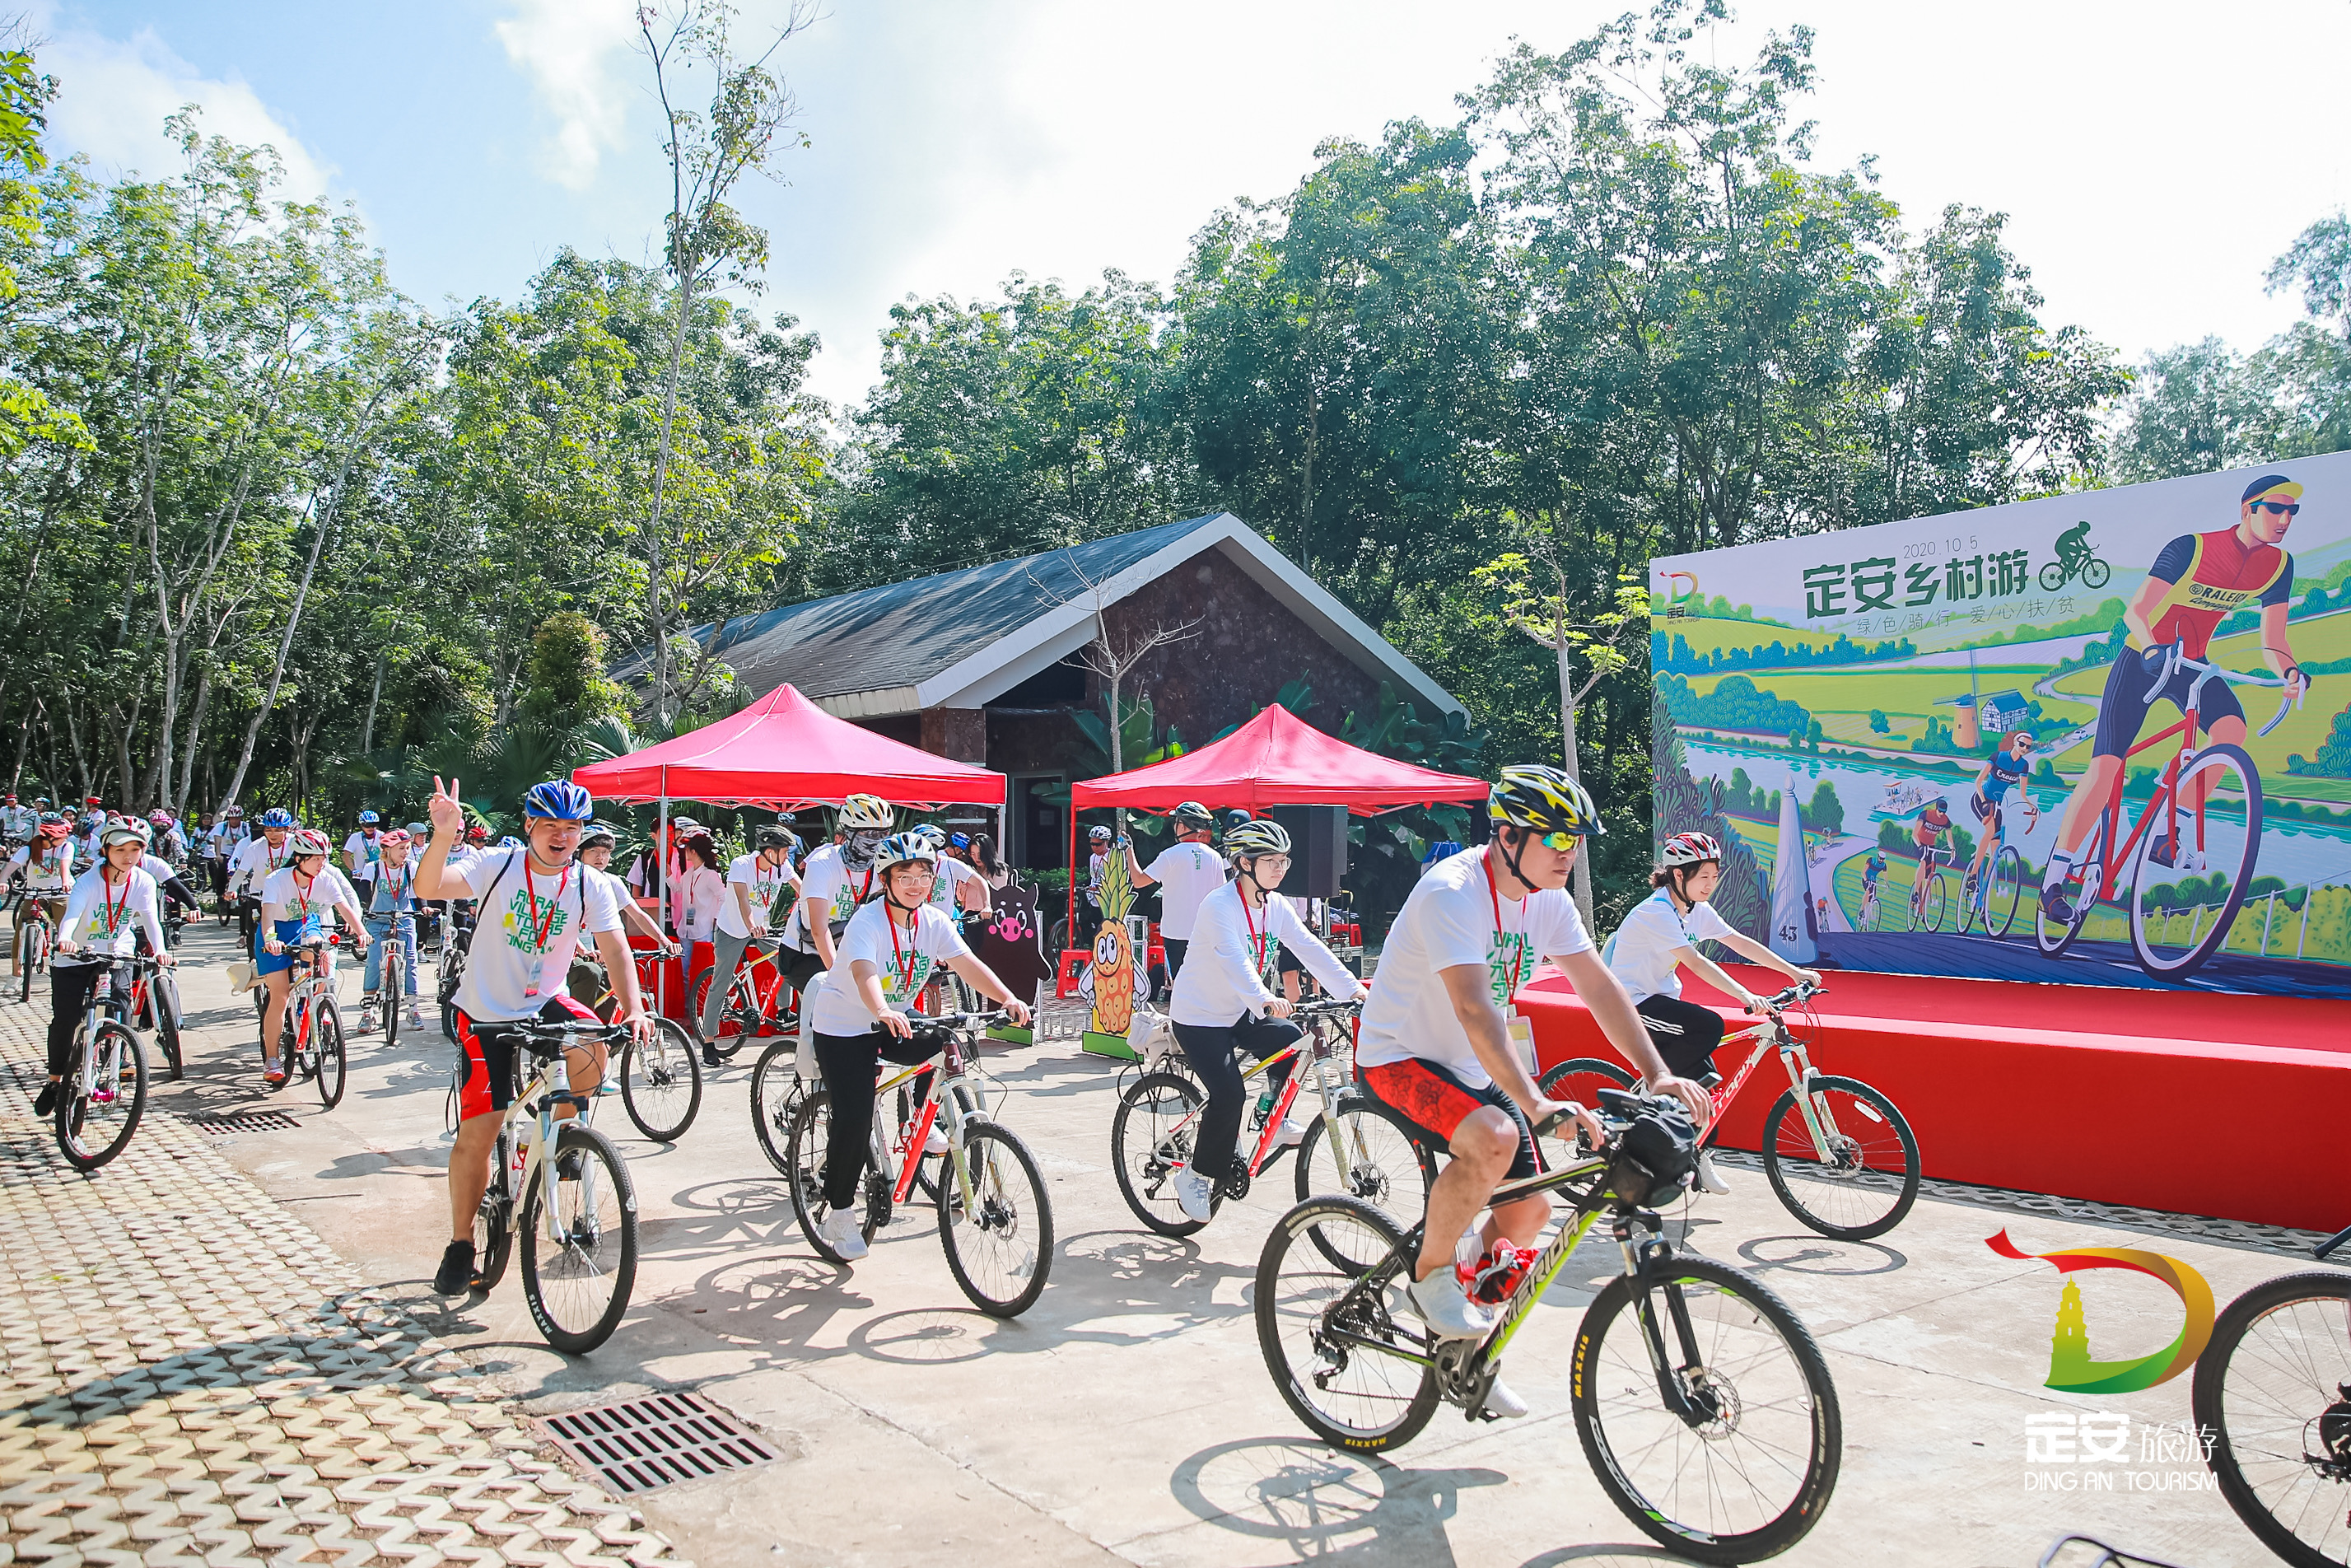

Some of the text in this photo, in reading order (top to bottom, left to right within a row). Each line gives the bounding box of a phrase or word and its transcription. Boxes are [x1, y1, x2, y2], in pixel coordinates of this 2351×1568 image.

[1803, 549, 2029, 619] 定安乡村游
[510, 897, 568, 924] VILAGE
[1778, 925, 1798, 942] 43
[1499, 1211, 1579, 1340] MERIDA
[529, 1294, 553, 1334] MAXXIS
[1574, 1334, 1589, 1398] MAXXIS
[1345, 1436, 1387, 1448] MAXXIS
